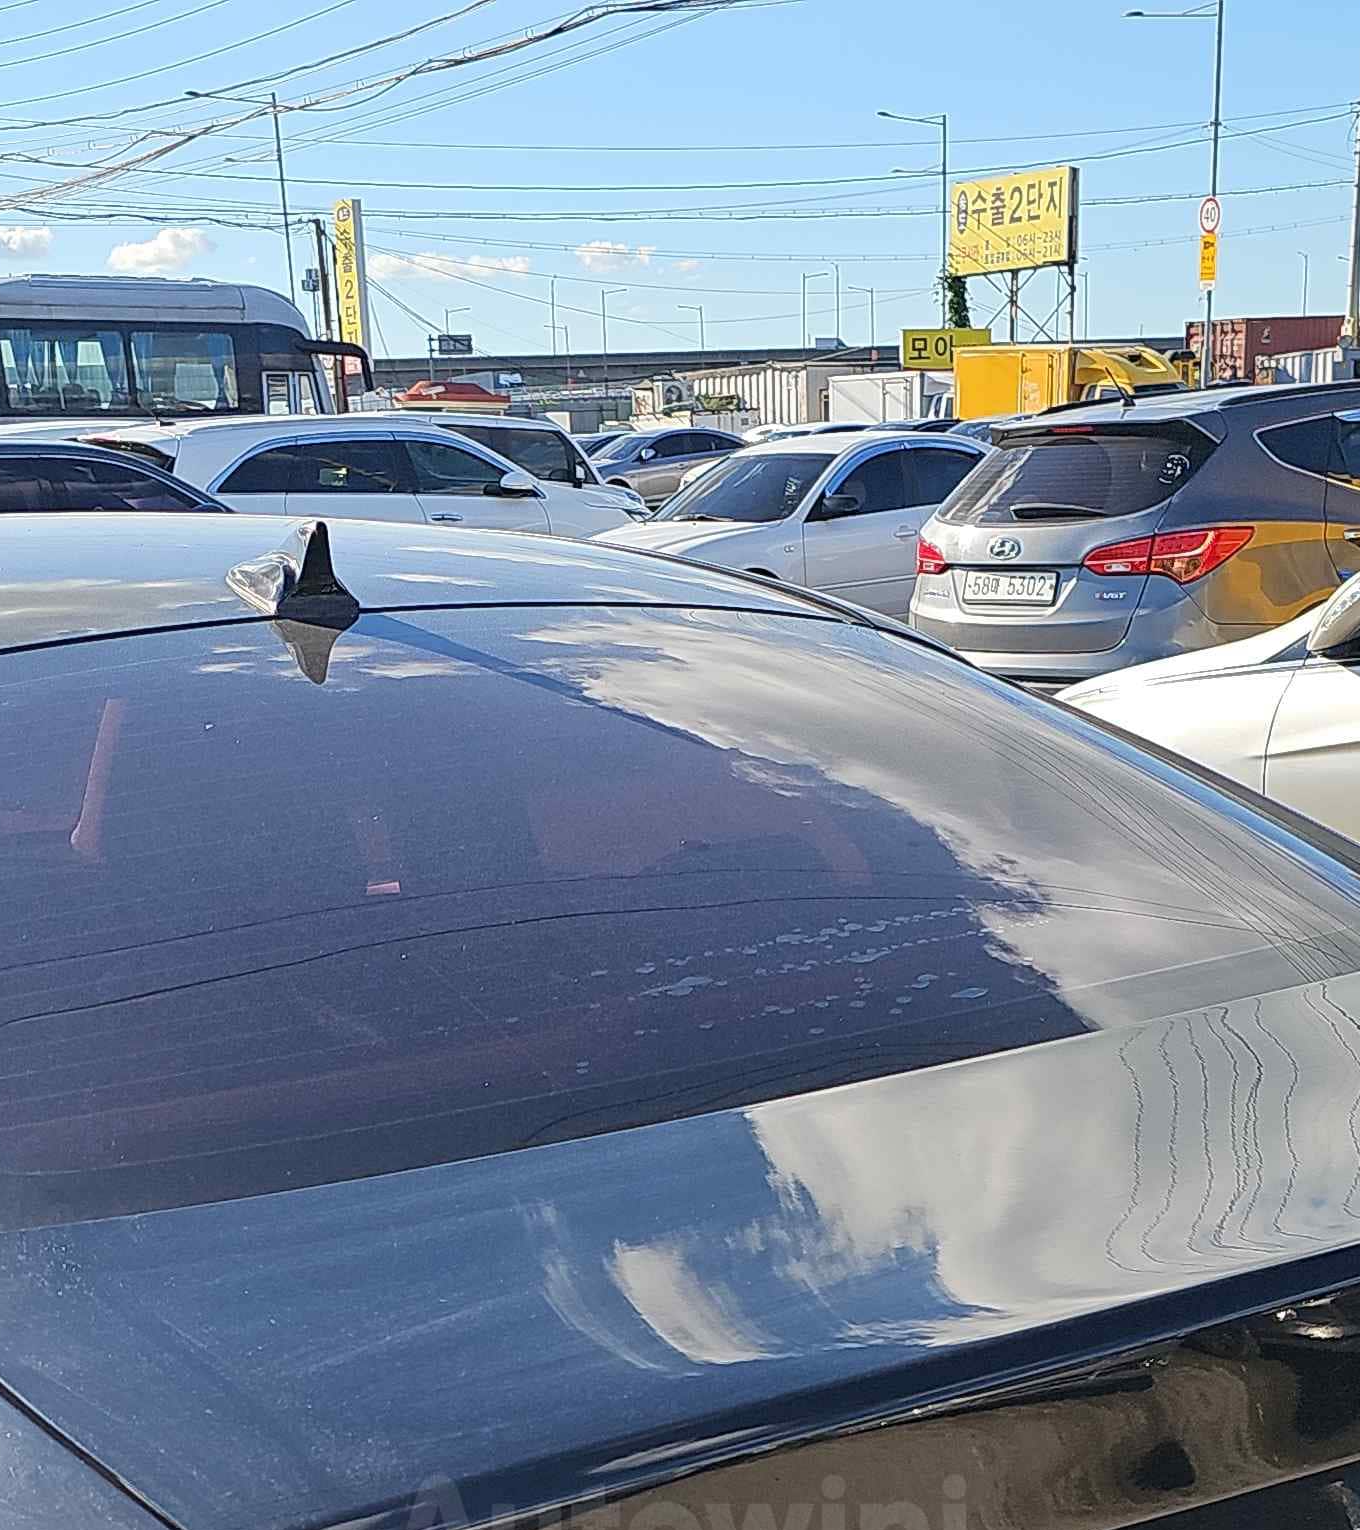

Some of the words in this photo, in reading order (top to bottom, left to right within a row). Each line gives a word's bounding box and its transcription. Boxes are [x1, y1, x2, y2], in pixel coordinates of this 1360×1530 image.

[971, 176, 1063, 231] 수출2단지
[1203, 206, 1217, 223] 40
[1007, 575, 1046, 597] 5302
